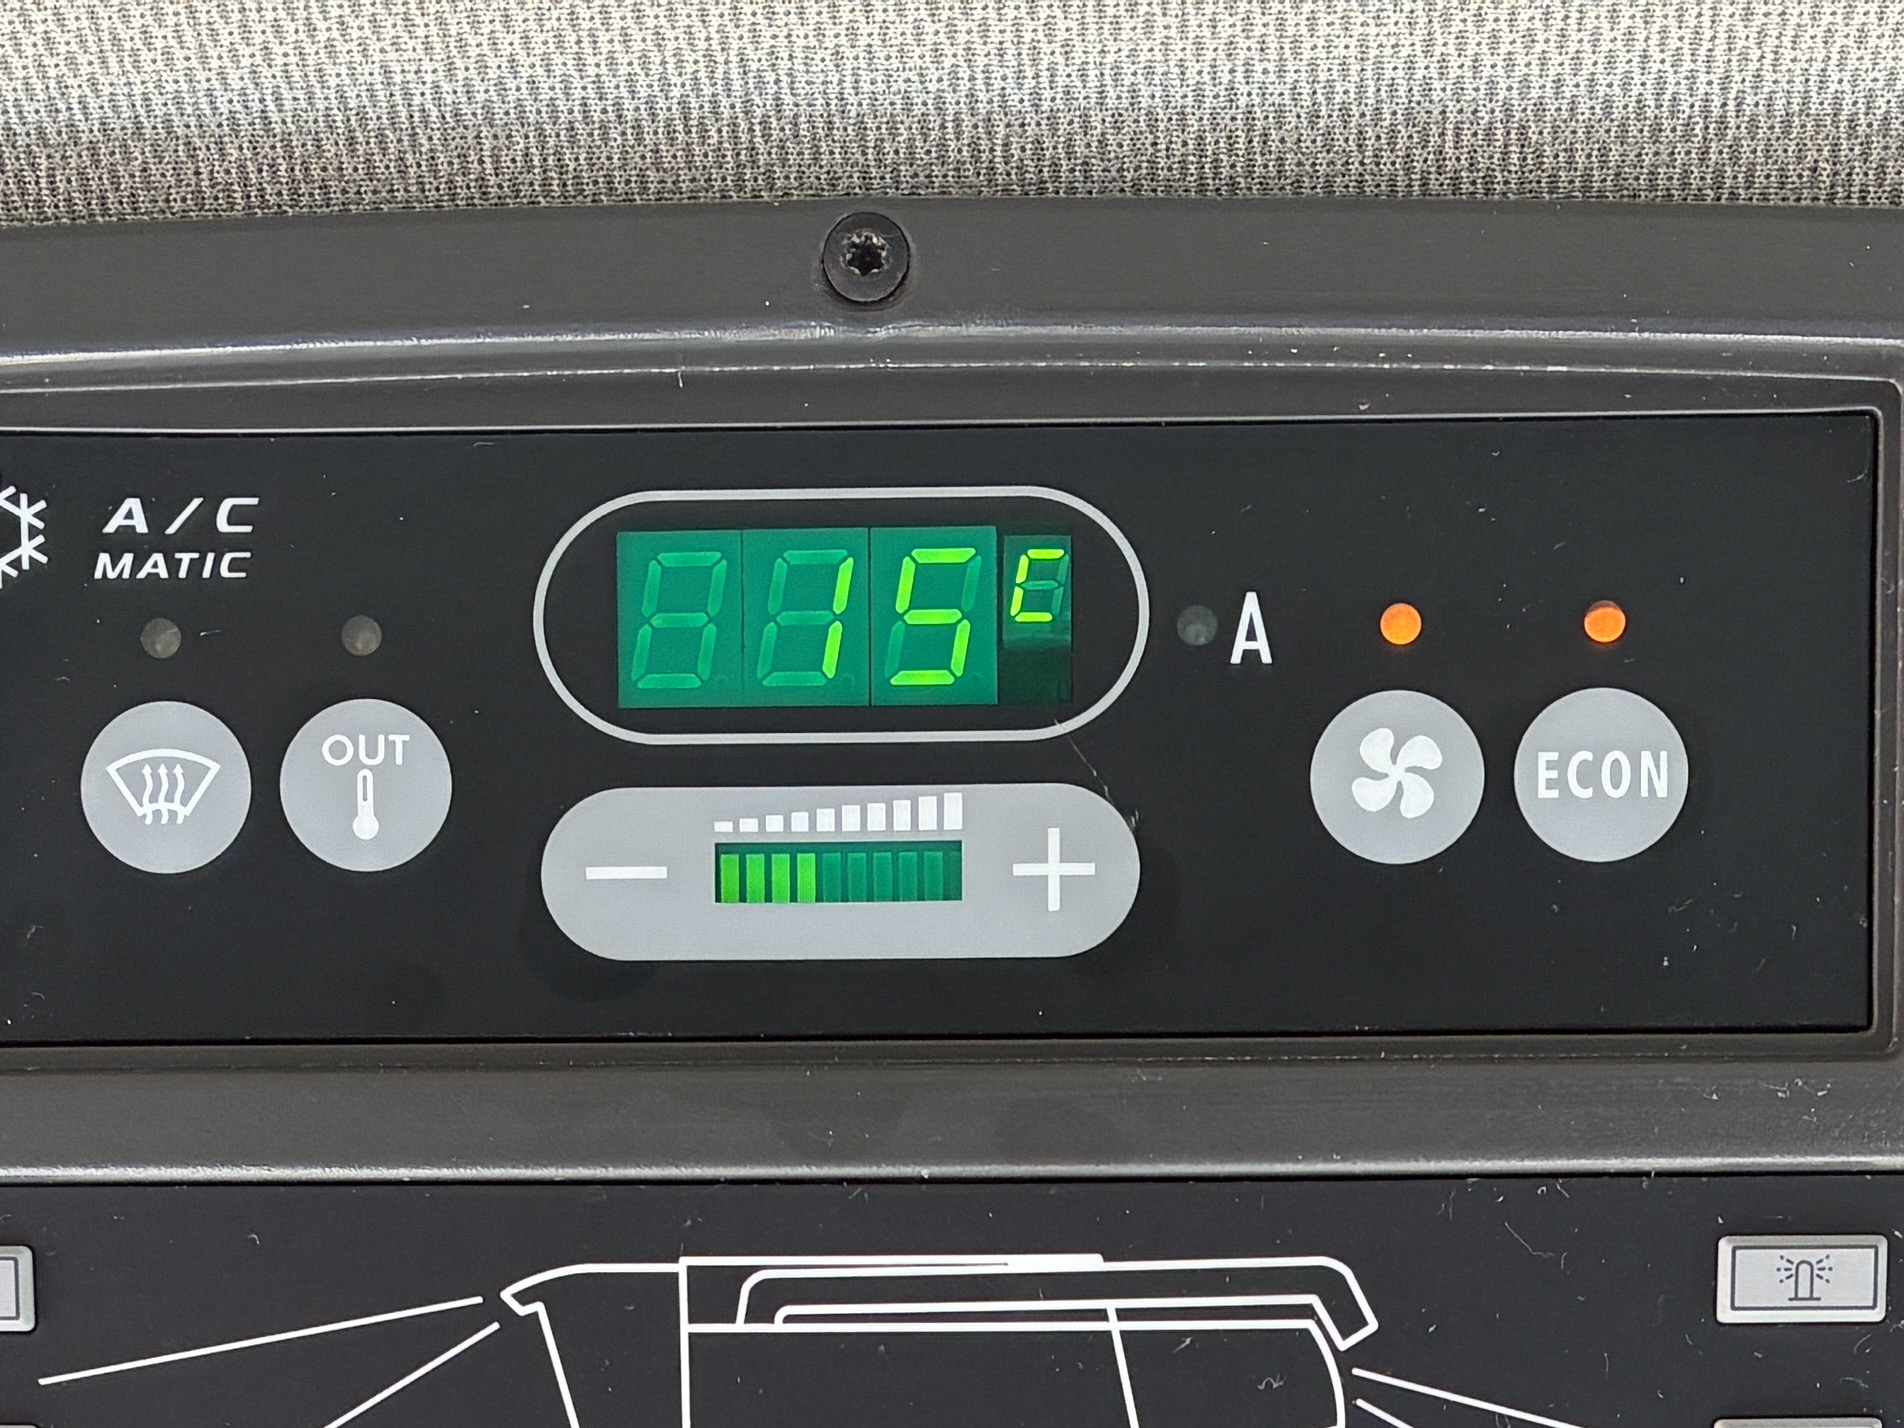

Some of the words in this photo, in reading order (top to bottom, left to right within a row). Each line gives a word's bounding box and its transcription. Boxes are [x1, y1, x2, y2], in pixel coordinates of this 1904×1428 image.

[103, 497, 260, 535] A/C
[94, 551, 252, 580] MATIC
[821, 546, 979, 686] 15
[1230, 591, 1273, 665] A
[321, 732, 411, 769] OUT
[1536, 749, 1669, 799] ECON
